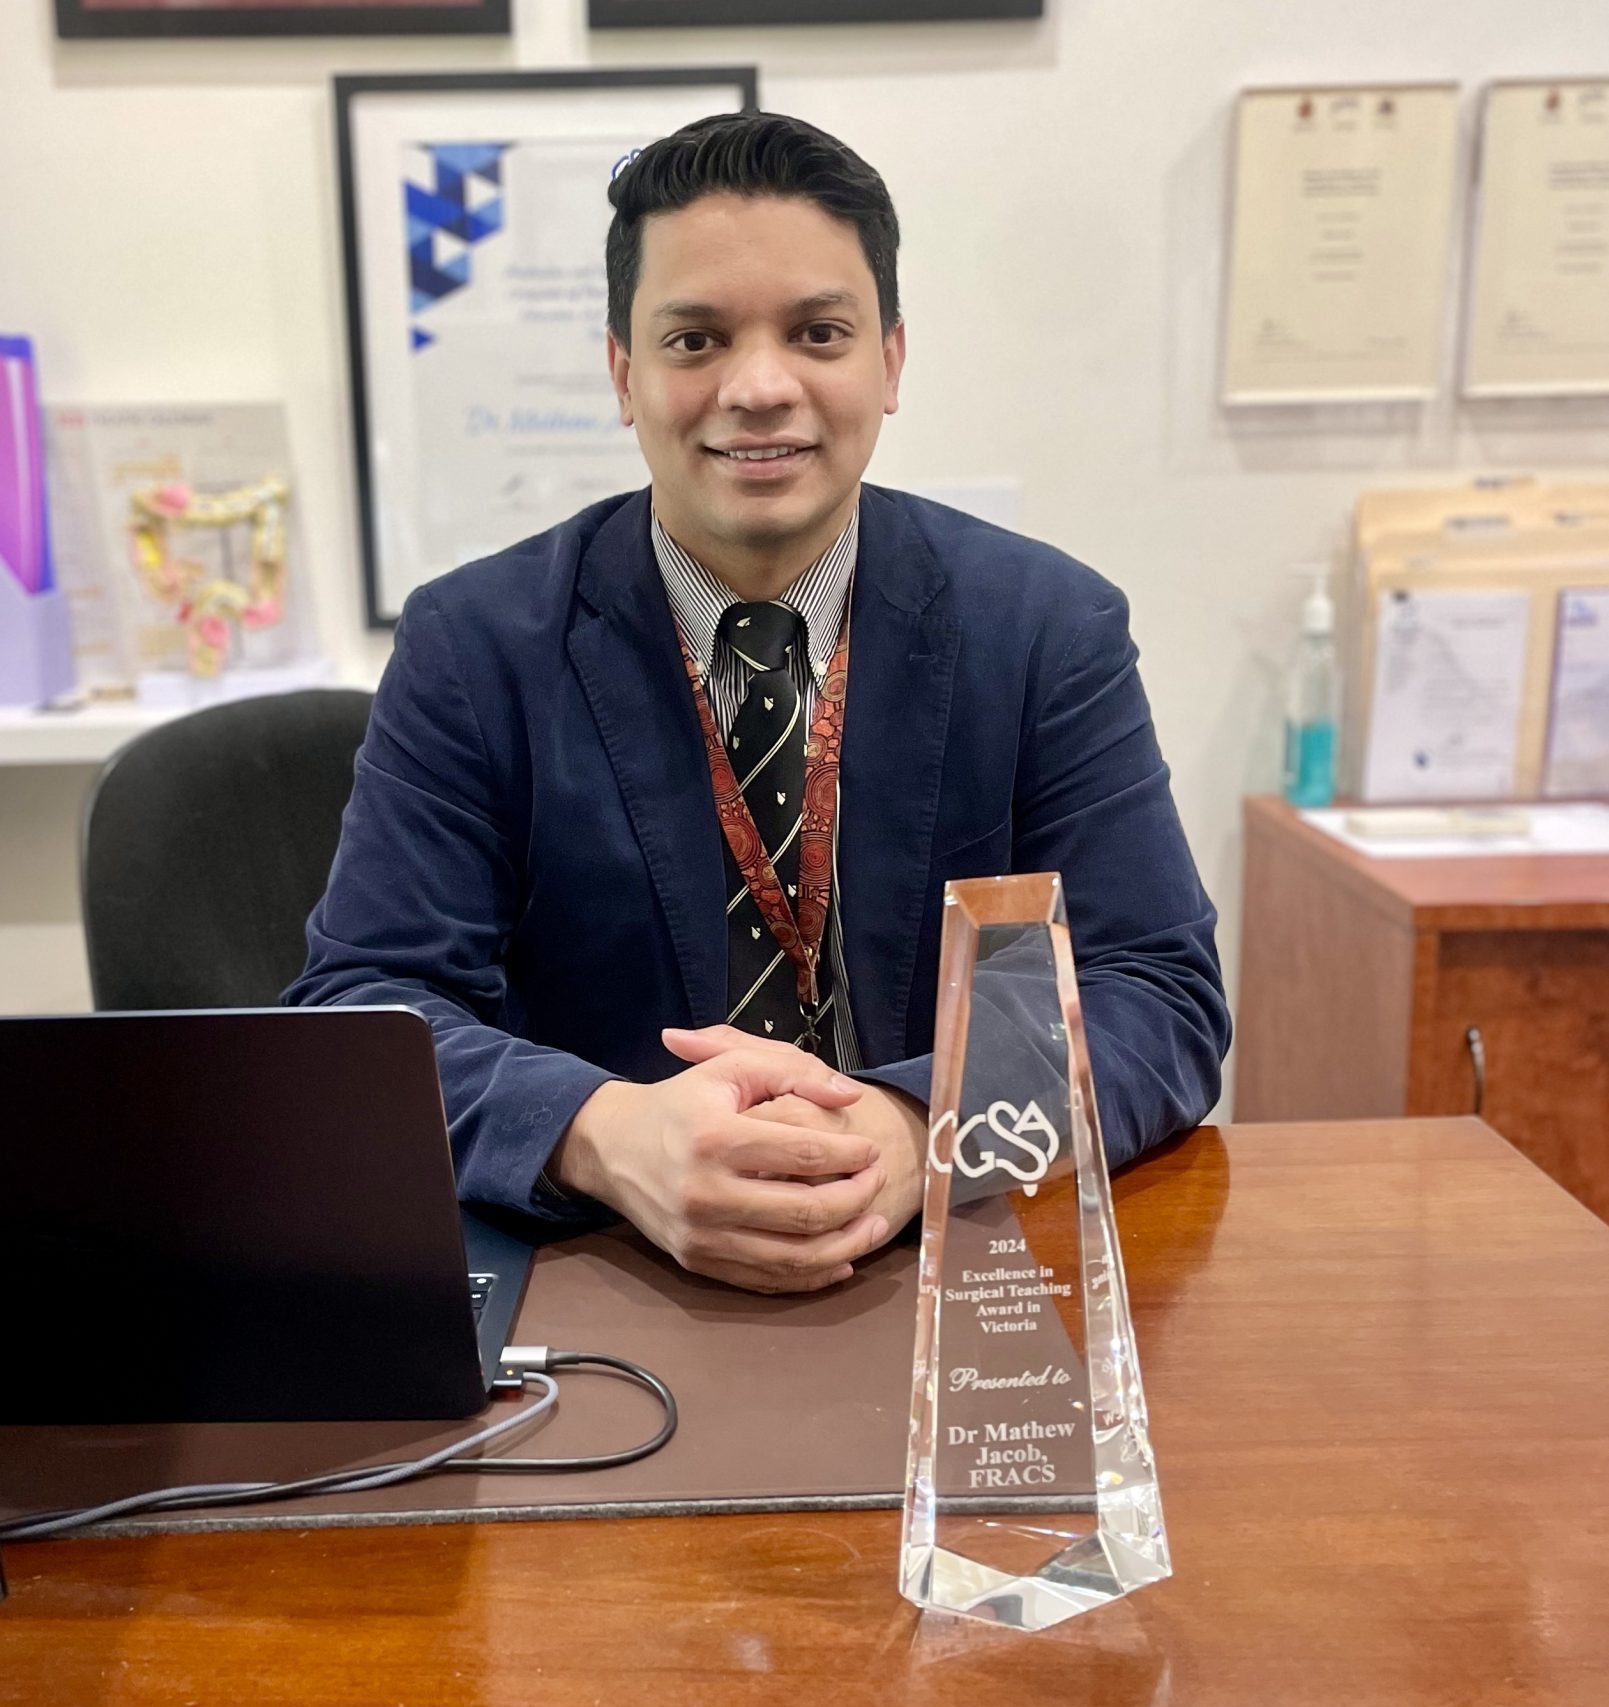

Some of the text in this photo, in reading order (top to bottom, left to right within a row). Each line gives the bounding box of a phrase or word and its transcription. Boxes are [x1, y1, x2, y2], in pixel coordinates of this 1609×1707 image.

[988, 1238, 1026, 1254] 2024
[962, 1265, 1053, 1283] Excellence in
[945, 1281, 1072, 1302] Surgical Teaching
[976, 1301, 1041, 1317] Award in
[981, 1319, 1037, 1333] Victoria
[949, 1365, 1071, 1392] Presented to
[948, 1421, 1076, 1445] Dr Mathew
[975, 1445, 1048, 1466] Jacob,
[968, 1465, 1056, 1488] FRACS
